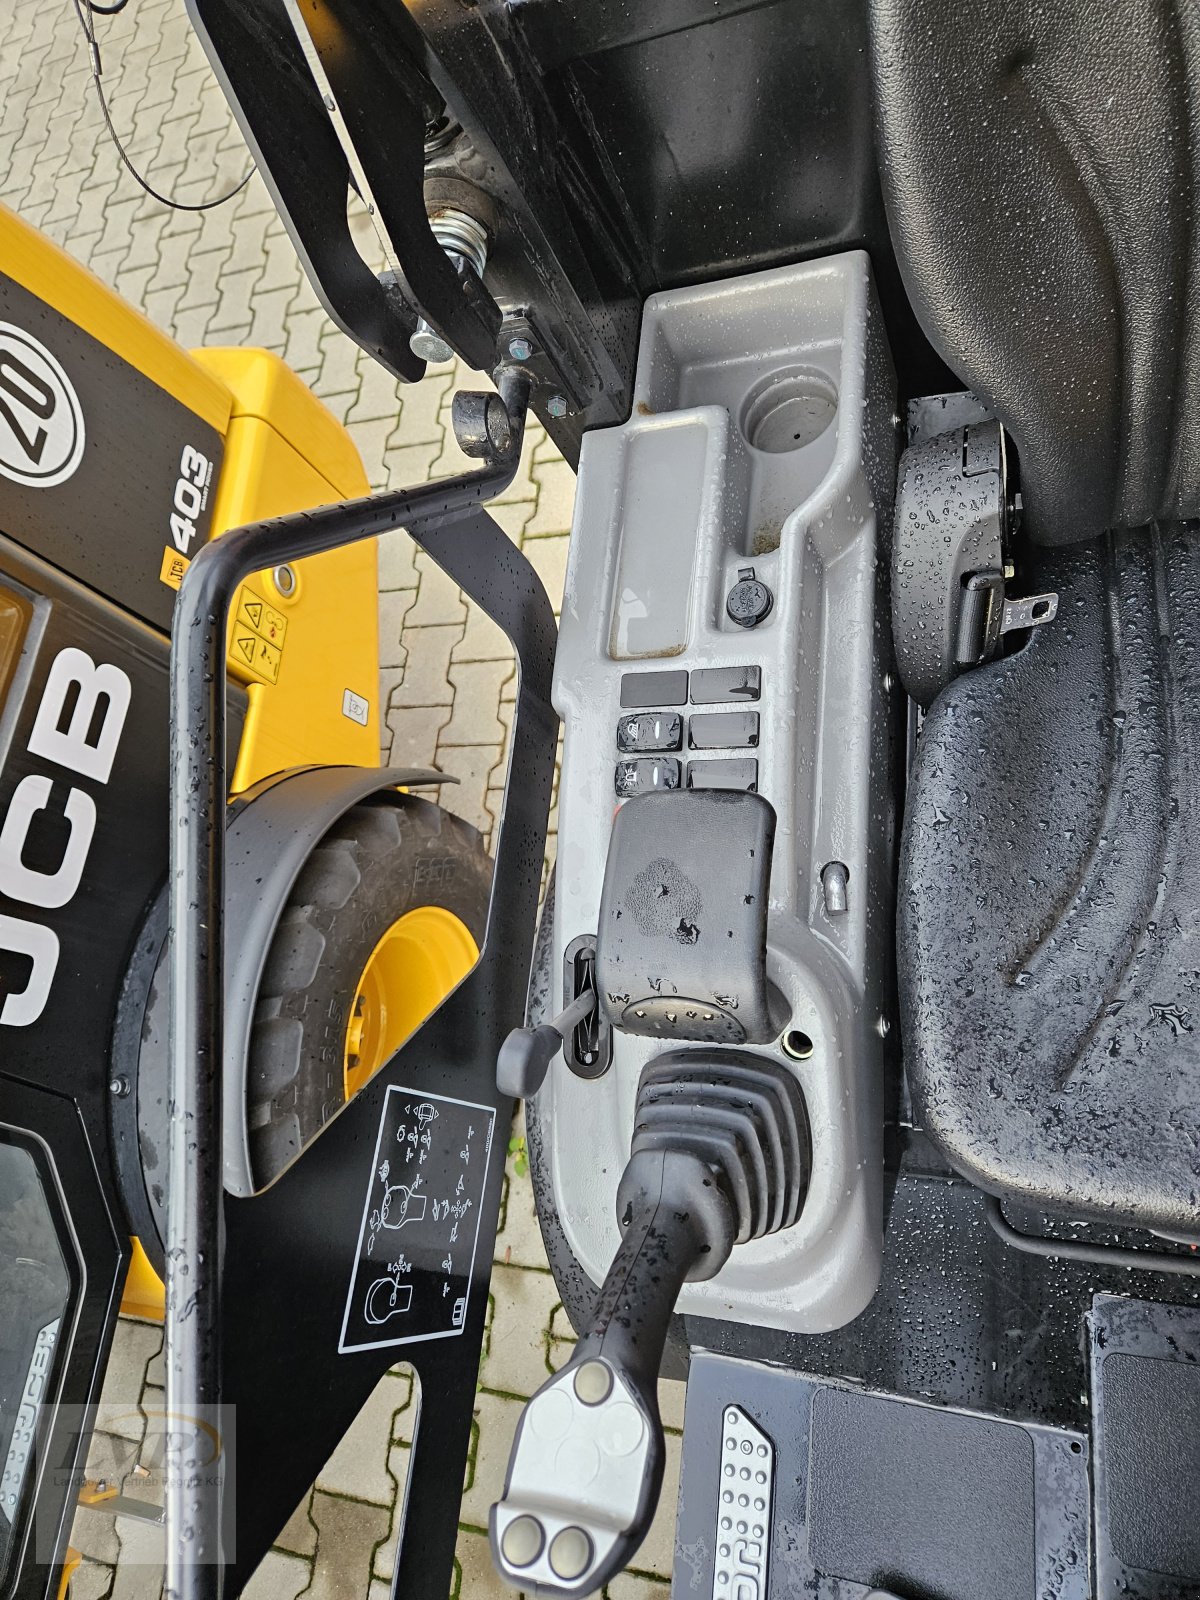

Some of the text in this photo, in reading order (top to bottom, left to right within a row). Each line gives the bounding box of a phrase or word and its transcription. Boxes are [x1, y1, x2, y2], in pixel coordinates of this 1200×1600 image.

[169, 444, 209, 554] 403
[170, 560, 184, 582] JCB
[0, 647, 132, 1027] JCB
[17, 1344, 52, 1430] JCB
